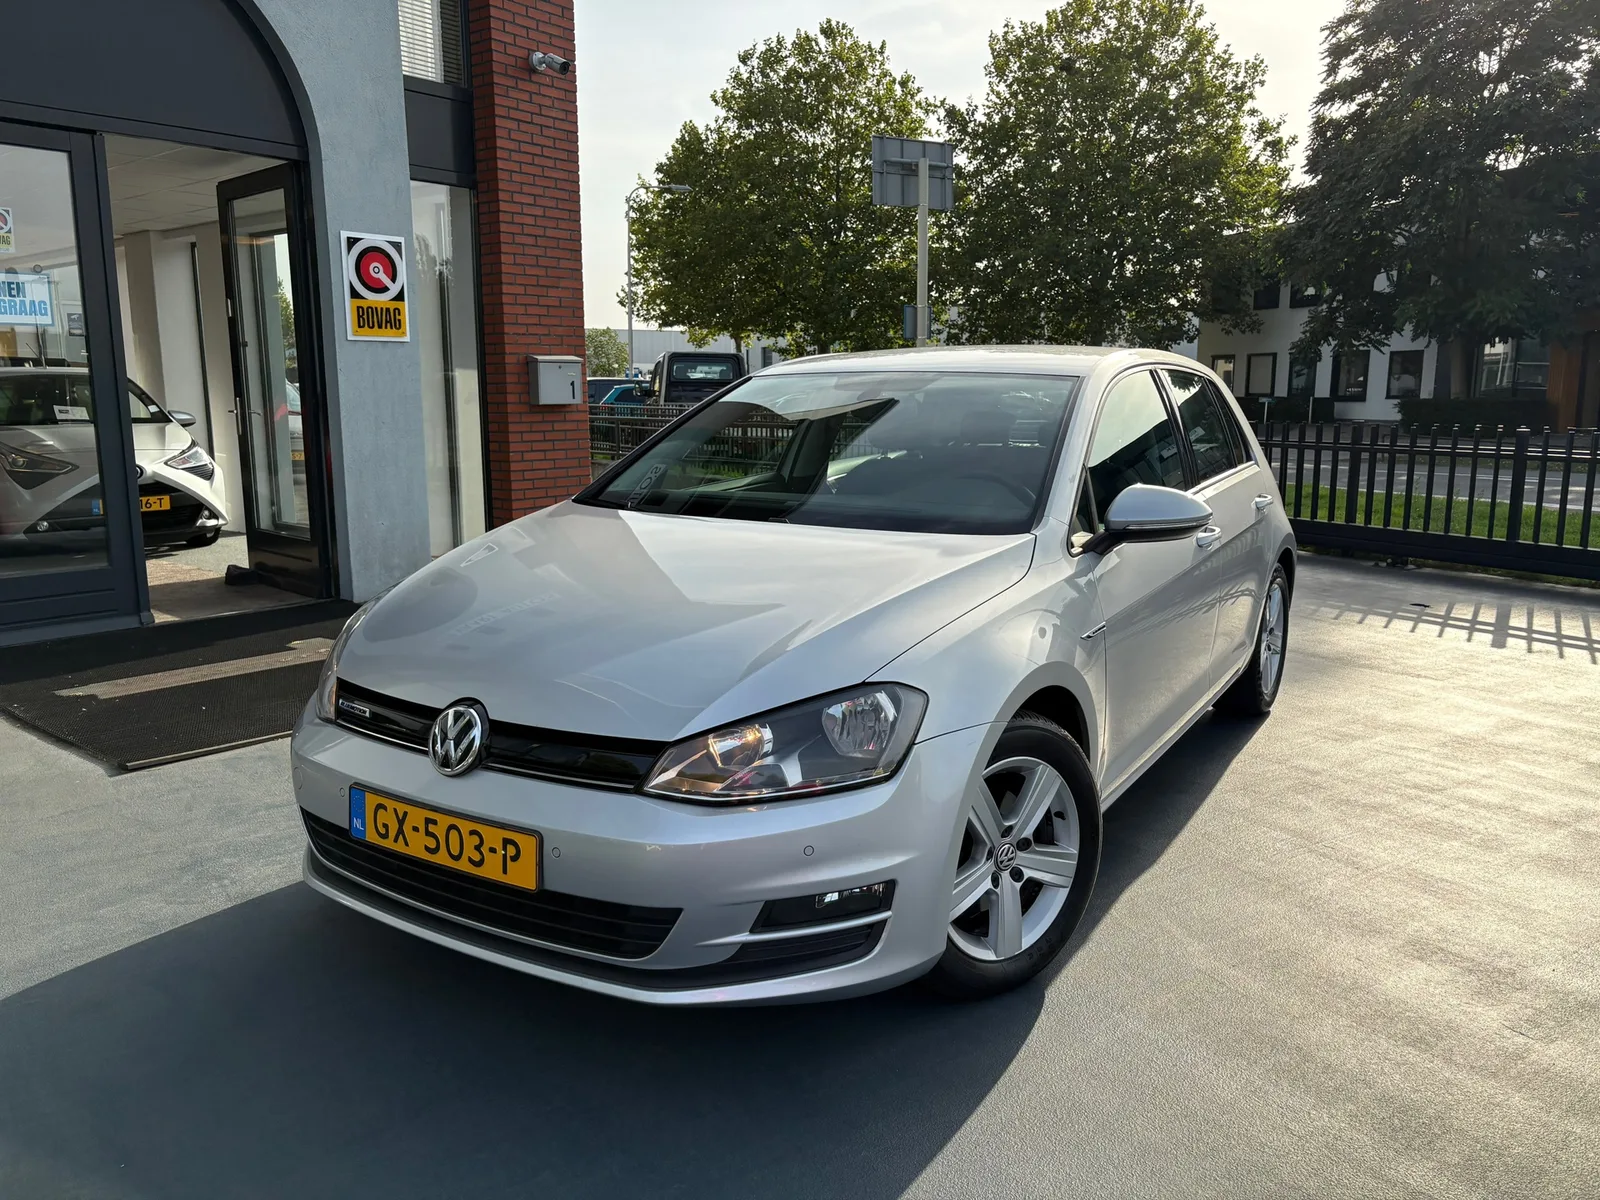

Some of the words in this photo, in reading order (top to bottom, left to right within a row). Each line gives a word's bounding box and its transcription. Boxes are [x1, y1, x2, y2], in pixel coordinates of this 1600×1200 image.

[356, 306, 402, 330] BOVAG
[570, 380, 576, 400] 1
[353, 817, 365, 831] NL
[372, 803, 522, 875] GX-503-P
